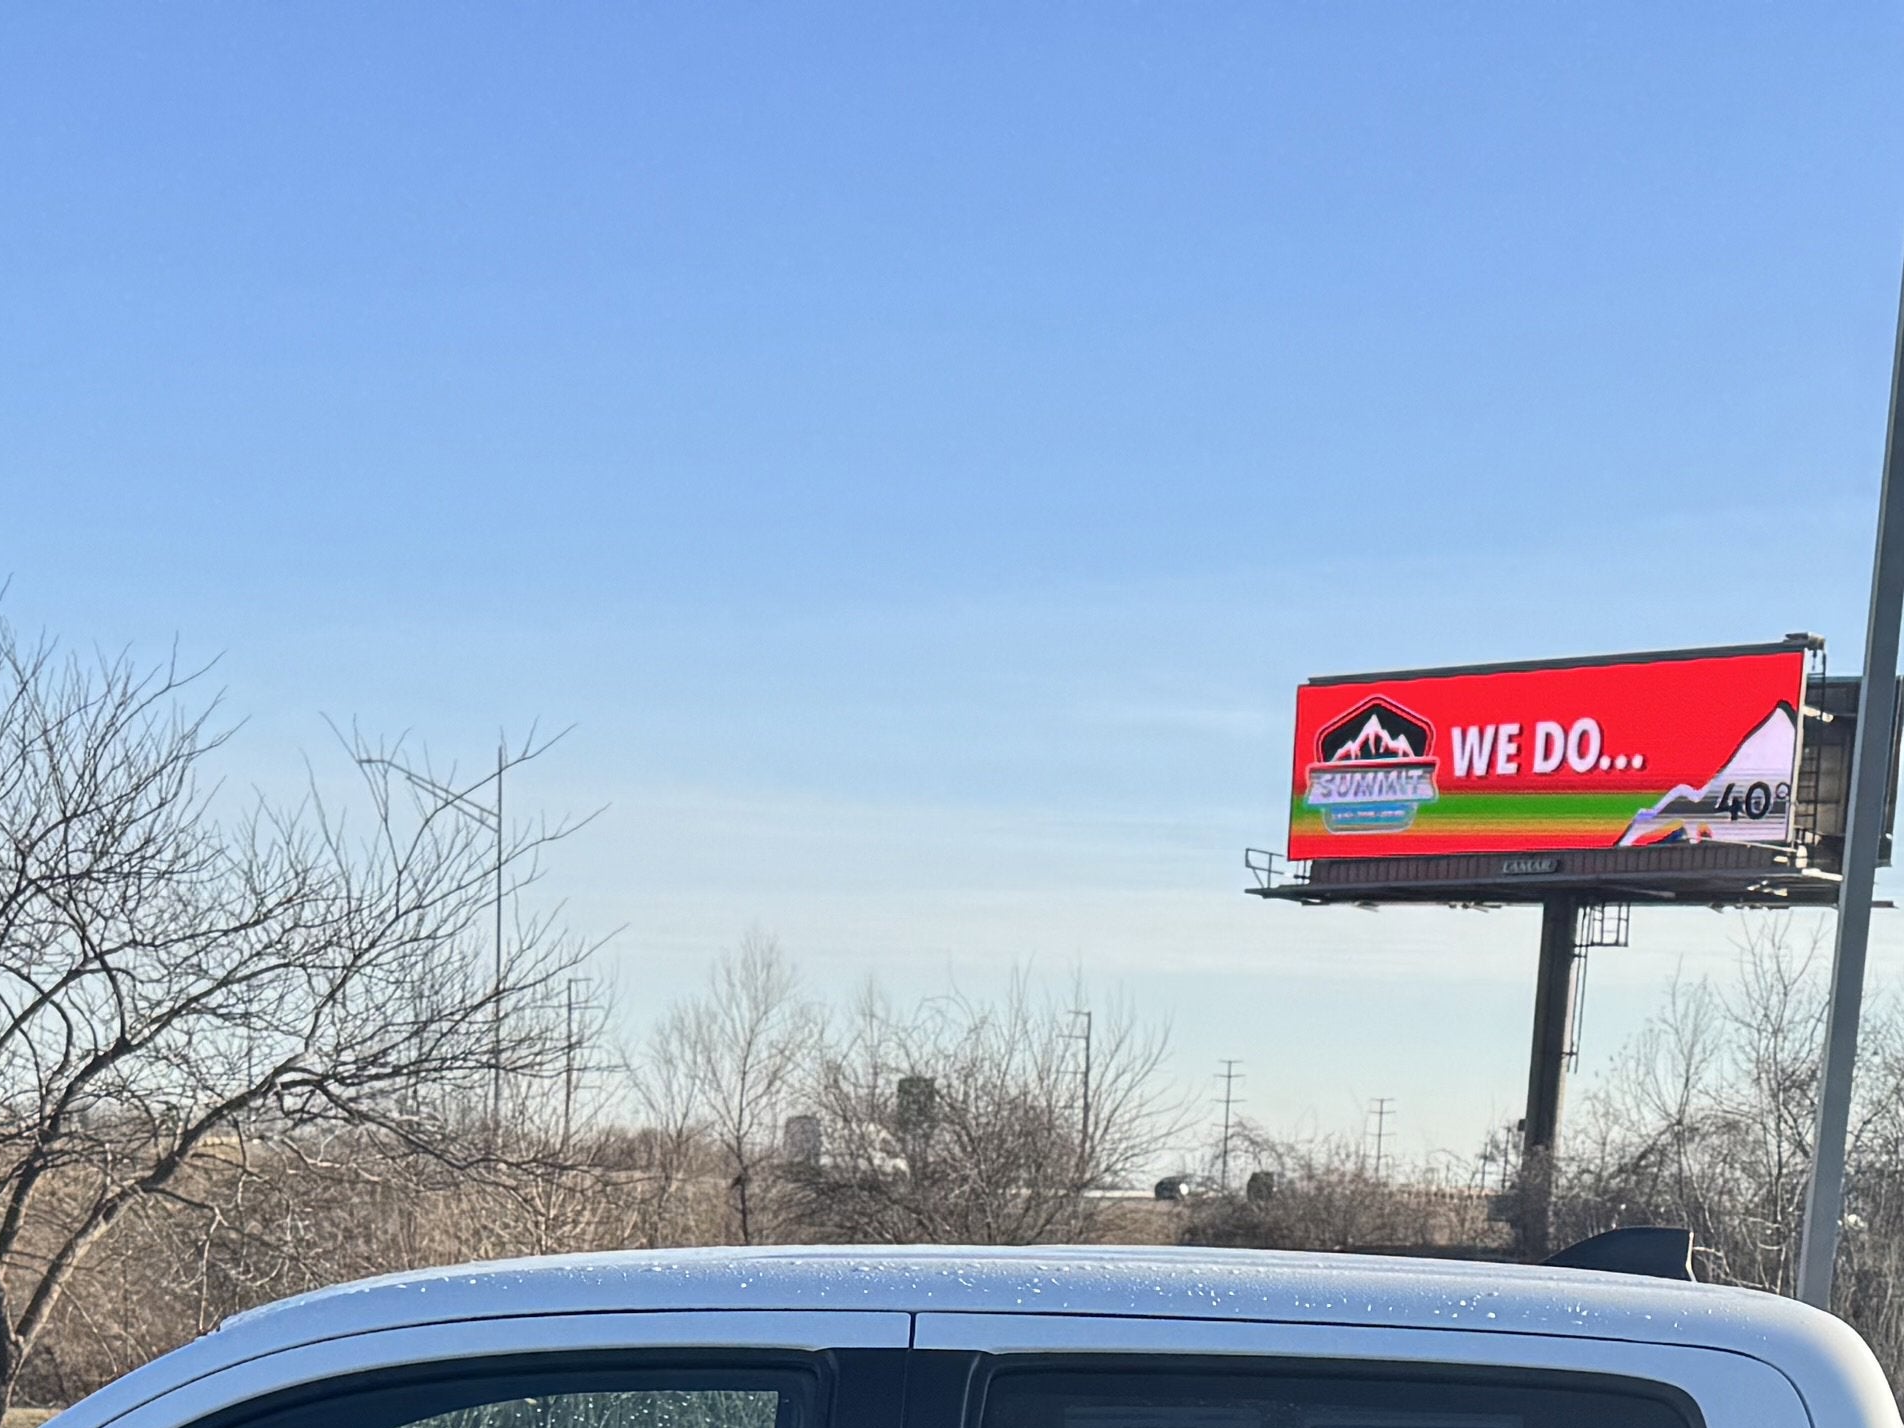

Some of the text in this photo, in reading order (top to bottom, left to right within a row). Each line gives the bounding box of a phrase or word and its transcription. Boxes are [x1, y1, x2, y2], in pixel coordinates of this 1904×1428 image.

[1451, 716, 1646, 778] WE DO...
[1319, 769, 1424, 799] SUMMIT
